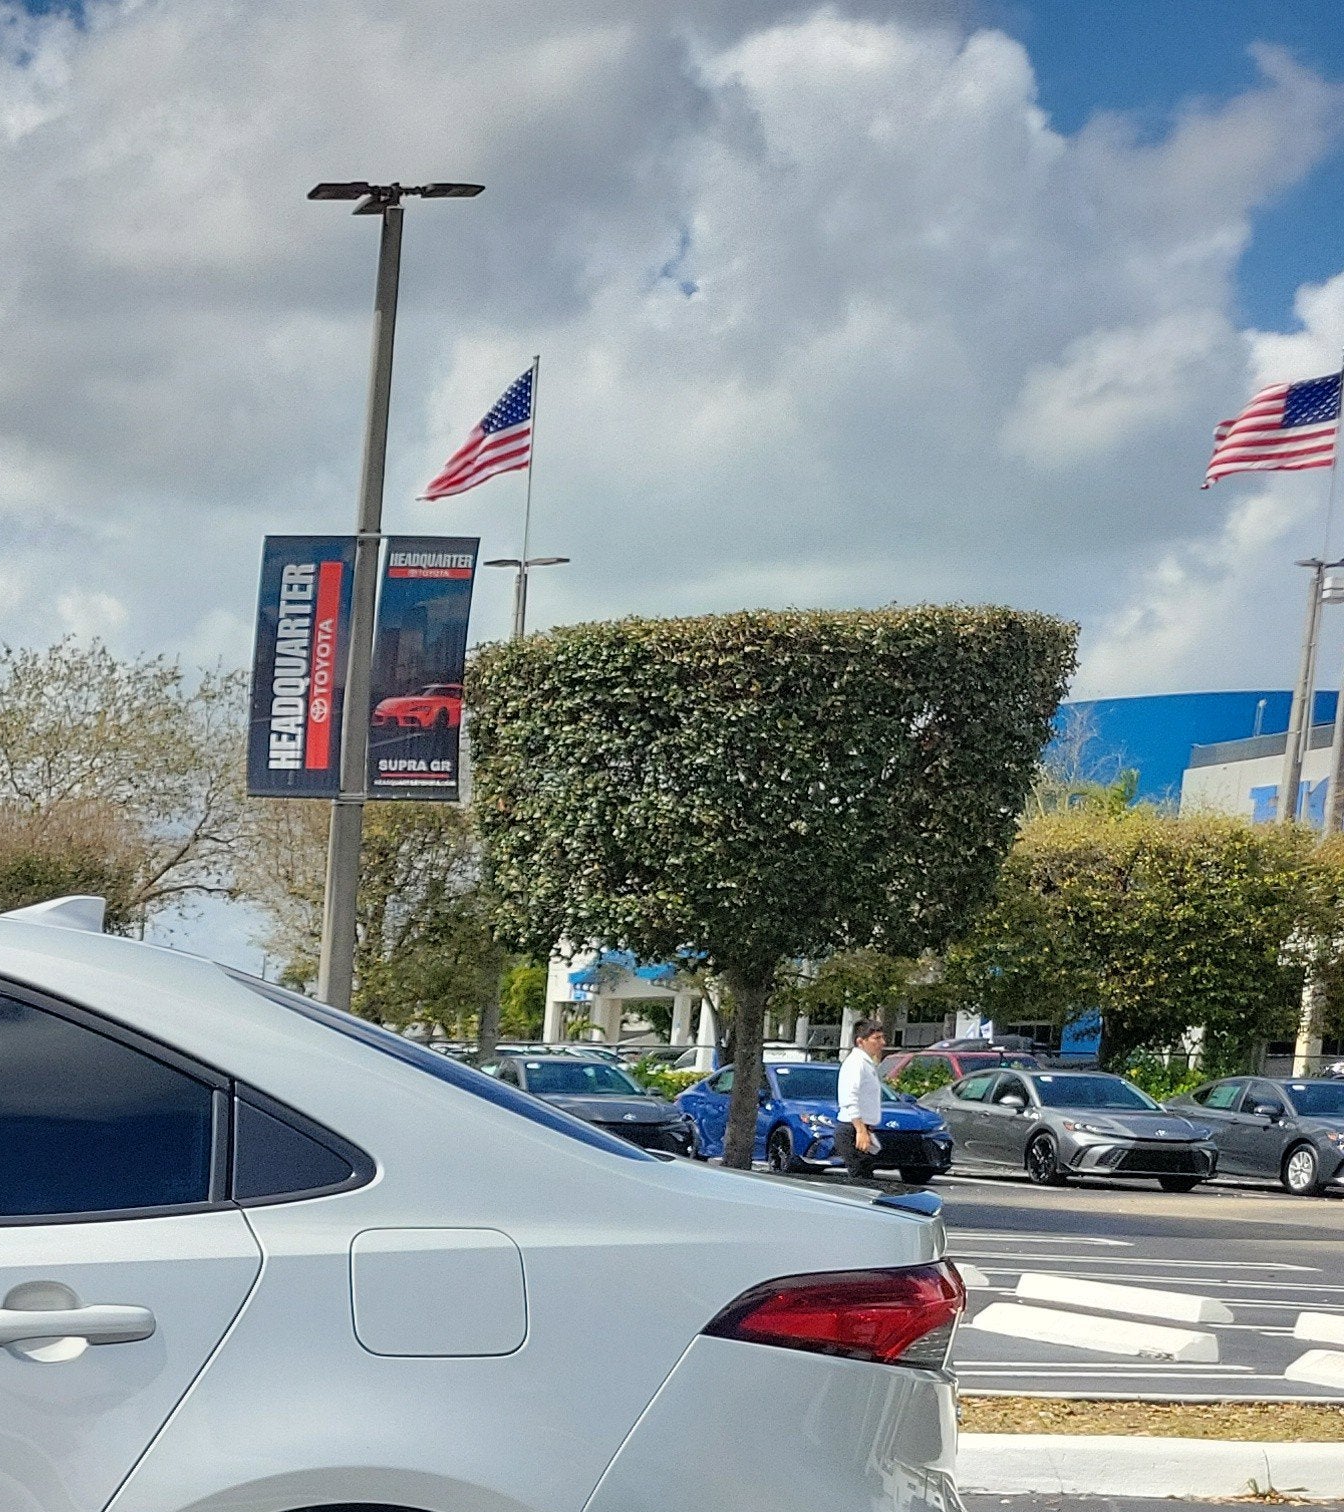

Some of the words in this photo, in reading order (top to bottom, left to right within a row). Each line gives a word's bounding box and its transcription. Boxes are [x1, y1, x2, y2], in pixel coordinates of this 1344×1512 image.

[390, 553, 474, 569] HEADQUARTER
[268, 564, 316, 770] HEADQUARTER
[314, 617, 335, 696] TOYOTA
[378, 759, 428, 771] SUPRA
[430, 760, 452, 772] GR
